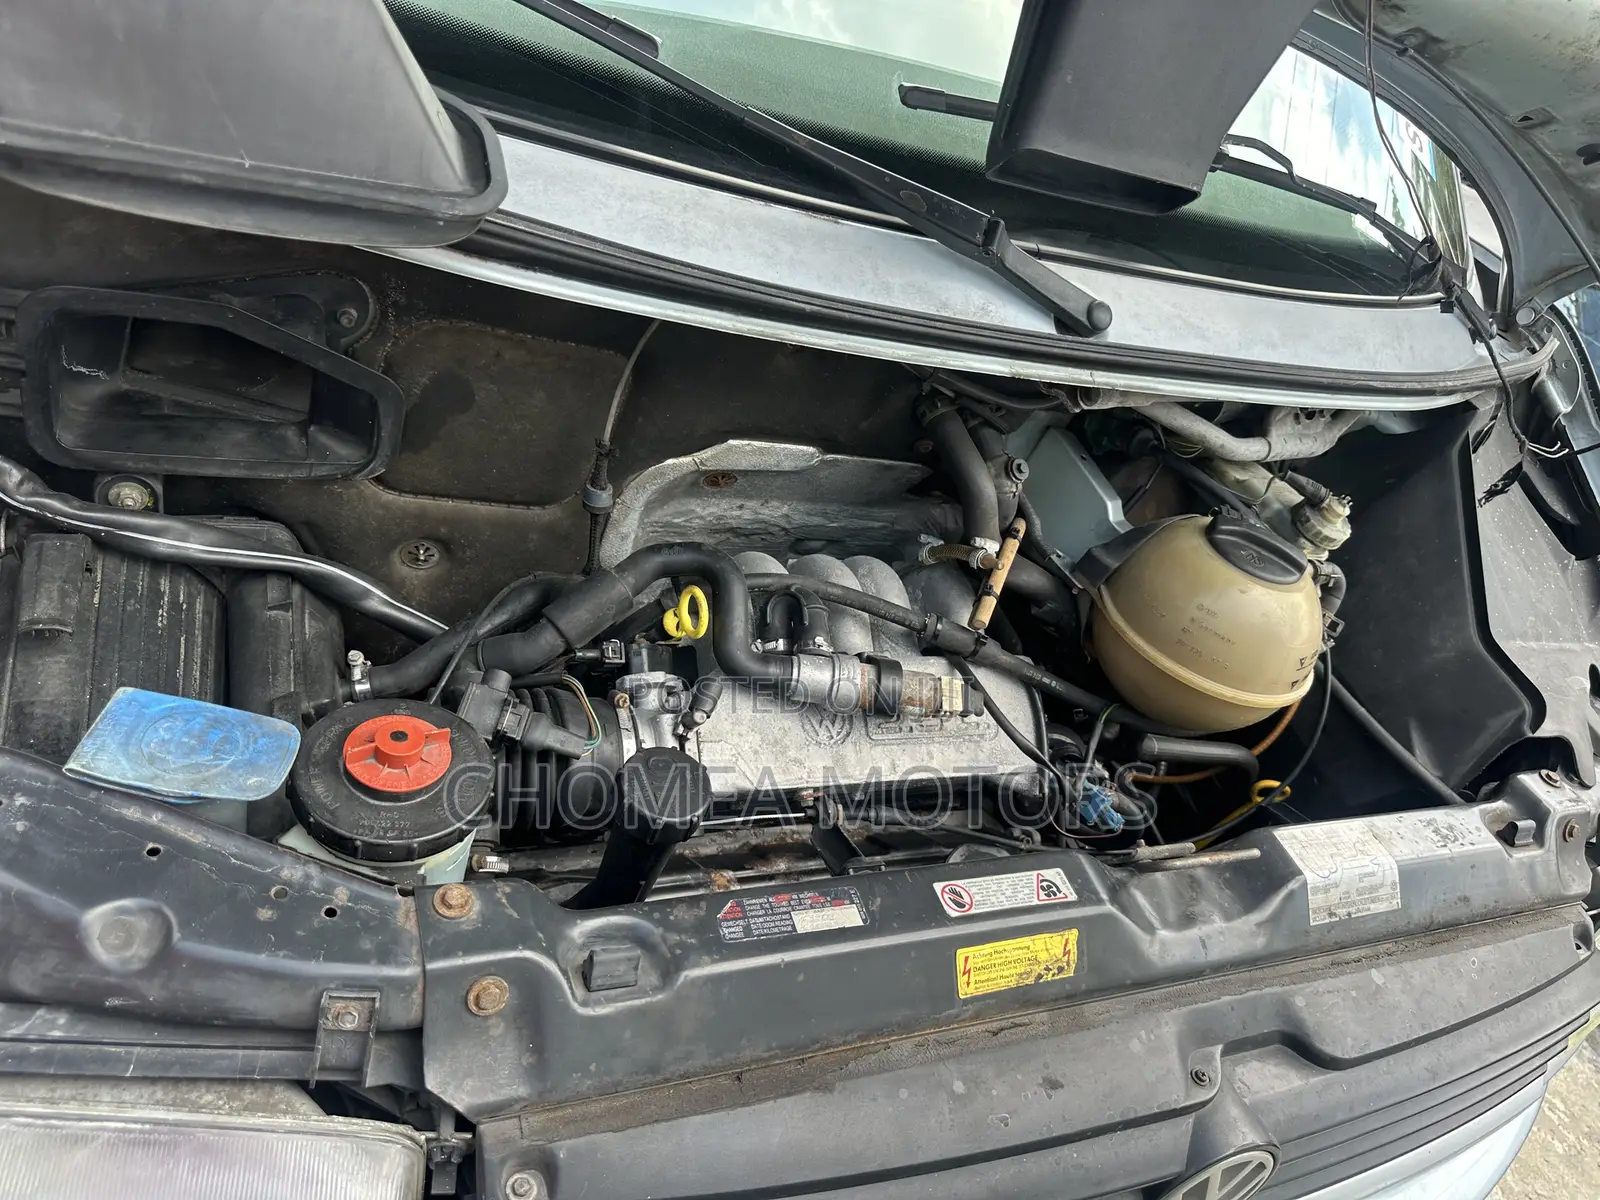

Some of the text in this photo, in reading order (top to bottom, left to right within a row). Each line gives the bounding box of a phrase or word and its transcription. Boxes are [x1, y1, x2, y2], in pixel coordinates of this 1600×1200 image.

[973, 962, 997, 973] DANGER
[997, 959, 1012, 968] HIGH
[1012, 954, 1039, 966] VOLTAGE
